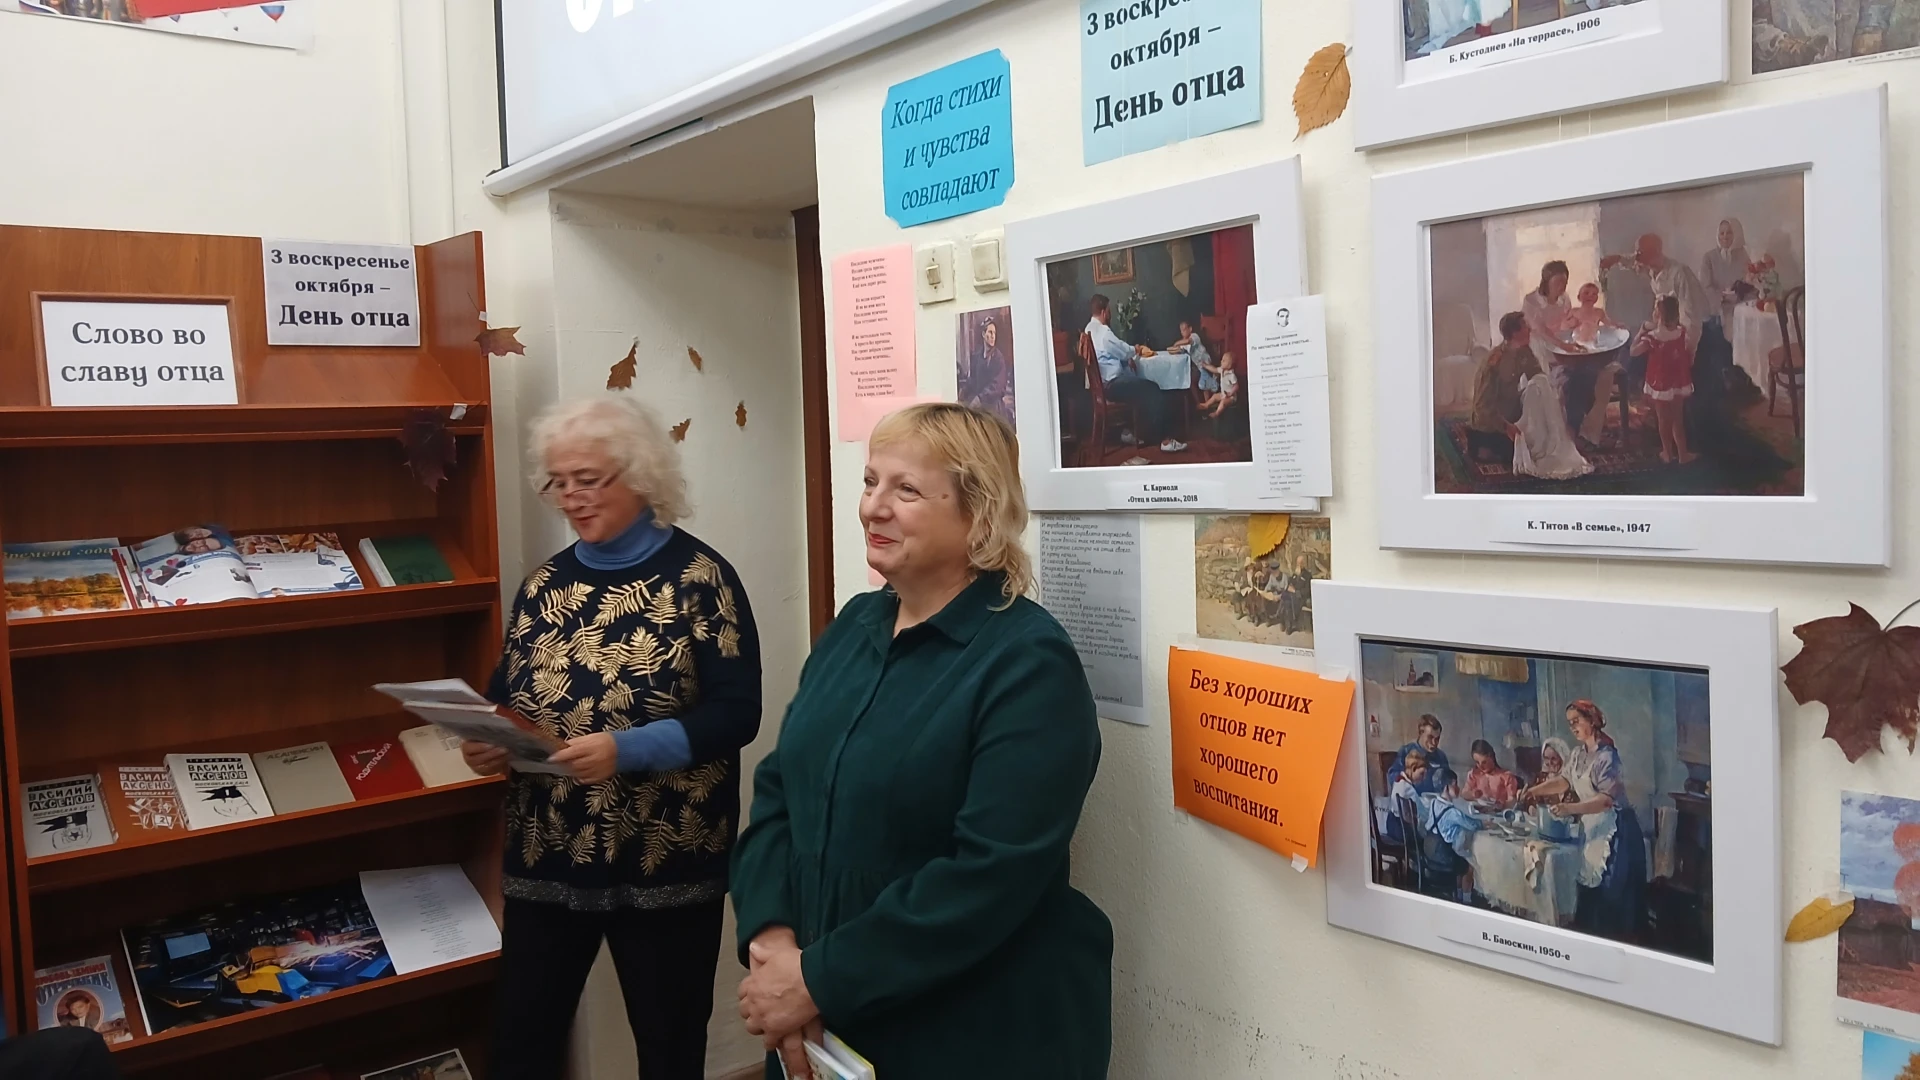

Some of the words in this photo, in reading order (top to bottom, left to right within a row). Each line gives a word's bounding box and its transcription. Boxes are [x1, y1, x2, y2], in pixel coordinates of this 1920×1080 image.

[1087, 12, 1099, 36] 3
[1110, 26, 1200, 70] октября
[1449, 54, 1458, 64] Б.
[1576, 17, 1601, 32] 1906
[891, 94, 943, 130] Когда
[948, 75, 1004, 110] стихи
[1093, 91, 1164, 134] День
[1172, 65, 1245, 106] отца
[903, 146, 917, 168] и
[921, 125, 990, 169] чувства
[901, 168, 1000, 211] совпадают
[270, 249, 283, 265] 3
[288, 252, 410, 270] воскресенье
[294, 278, 375, 297] октября
[278, 304, 344, 328] День
[351, 311, 410, 329] отца
[72, 322, 164, 345] Слово
[172, 329, 206, 345] во
[61, 365, 148, 388] славу
[157, 365, 225, 383] отца
[1527, 521, 1538, 530] К.
[1540, 521, 1569, 531] Титов
[1626, 523, 1651, 533] 1947
[1190, 669, 1219, 694] Без
[1223, 681, 1313, 715] хороших
[1200, 712, 1247, 738] отцов
[1252, 725, 1287, 747] нет
[120, 773, 170, 781] ВАСИЛИ
[188, 762, 244, 772] ВАСИЛИЙ
[189, 771, 248, 781] АКСЕНОВ
[1200, 747, 1279, 785] хорошего
[28, 784, 93, 802] ВАСИЛИЙ
[120, 781, 173, 790] АКСЕНО
[29, 793, 95, 812] АКСЕНОВ
[1193, 778, 1284, 827] воспитания.
[1482, 932, 1492, 942] В.
